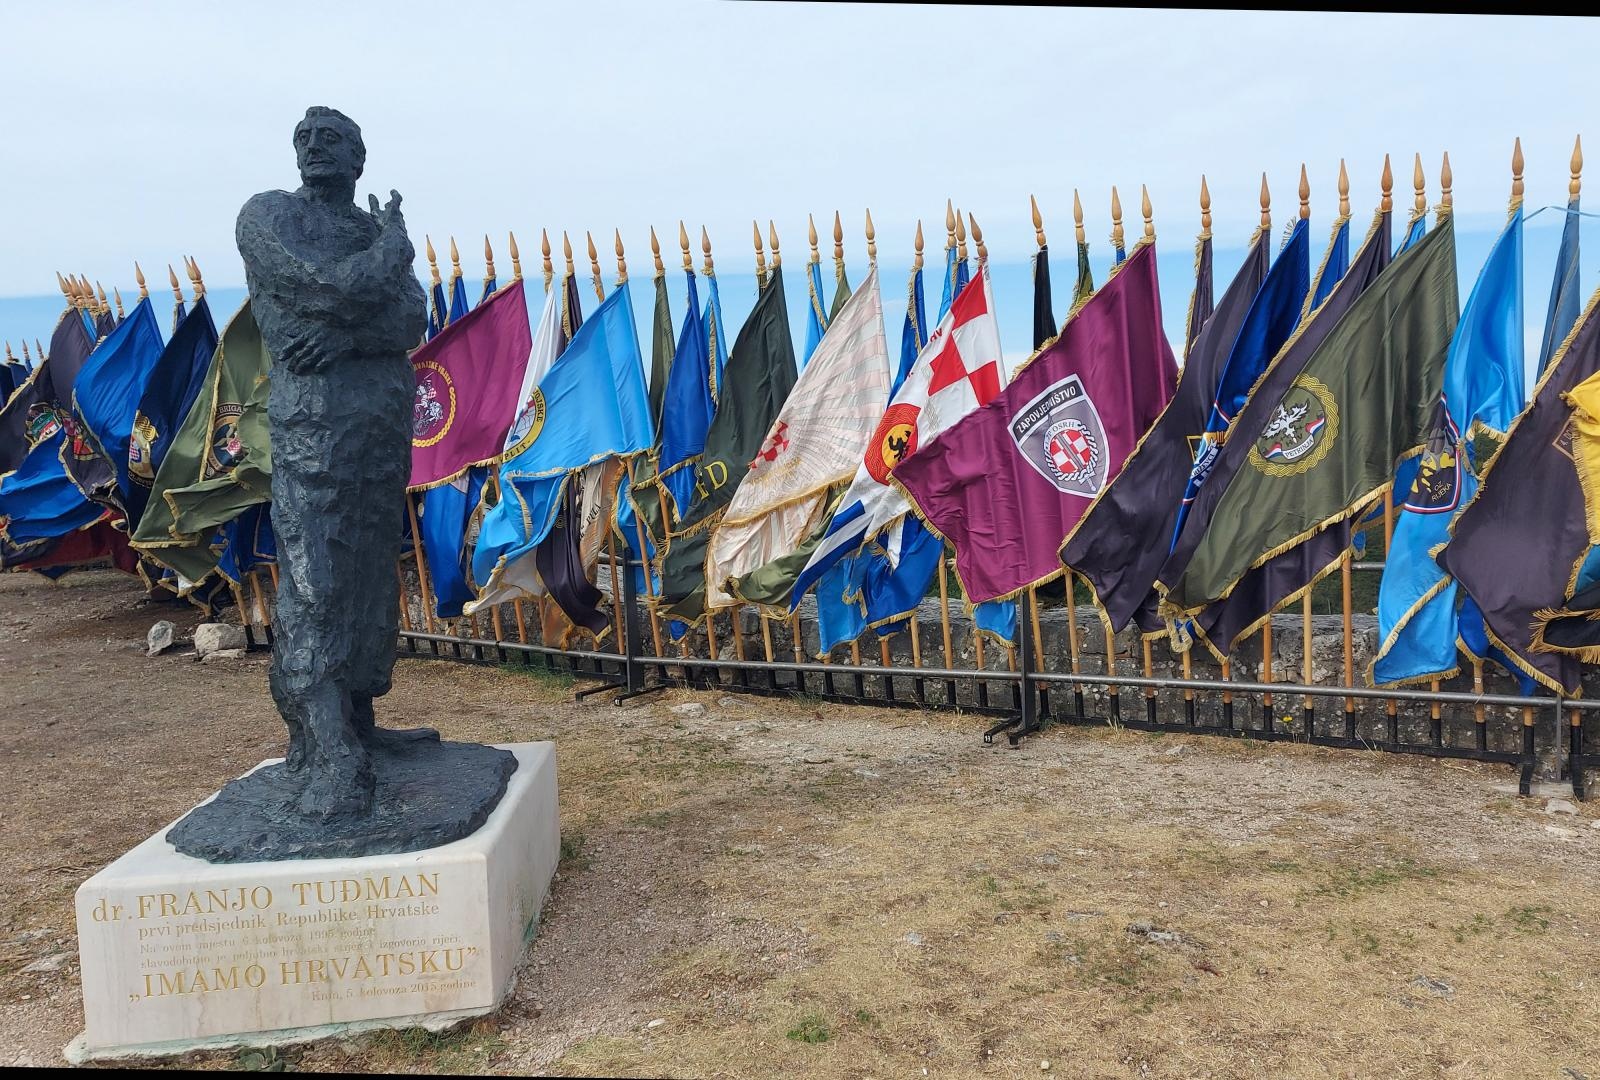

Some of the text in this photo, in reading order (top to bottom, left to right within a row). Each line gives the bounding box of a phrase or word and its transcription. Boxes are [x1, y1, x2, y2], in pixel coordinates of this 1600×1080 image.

[219, 404, 243, 414] BRIGA
[504, 442, 527, 461] PLIT
[1285, 438, 1314, 457] PETRINJA
[1431, 482, 1453, 502] RIJEKA
[292, 872, 441, 906] TUĐMAN
[138, 900, 440, 941] prvi predsjednik Republike Hrvatske
[379, 935, 426, 950] izgovorio
[360, 985, 407, 998] kolovoza
